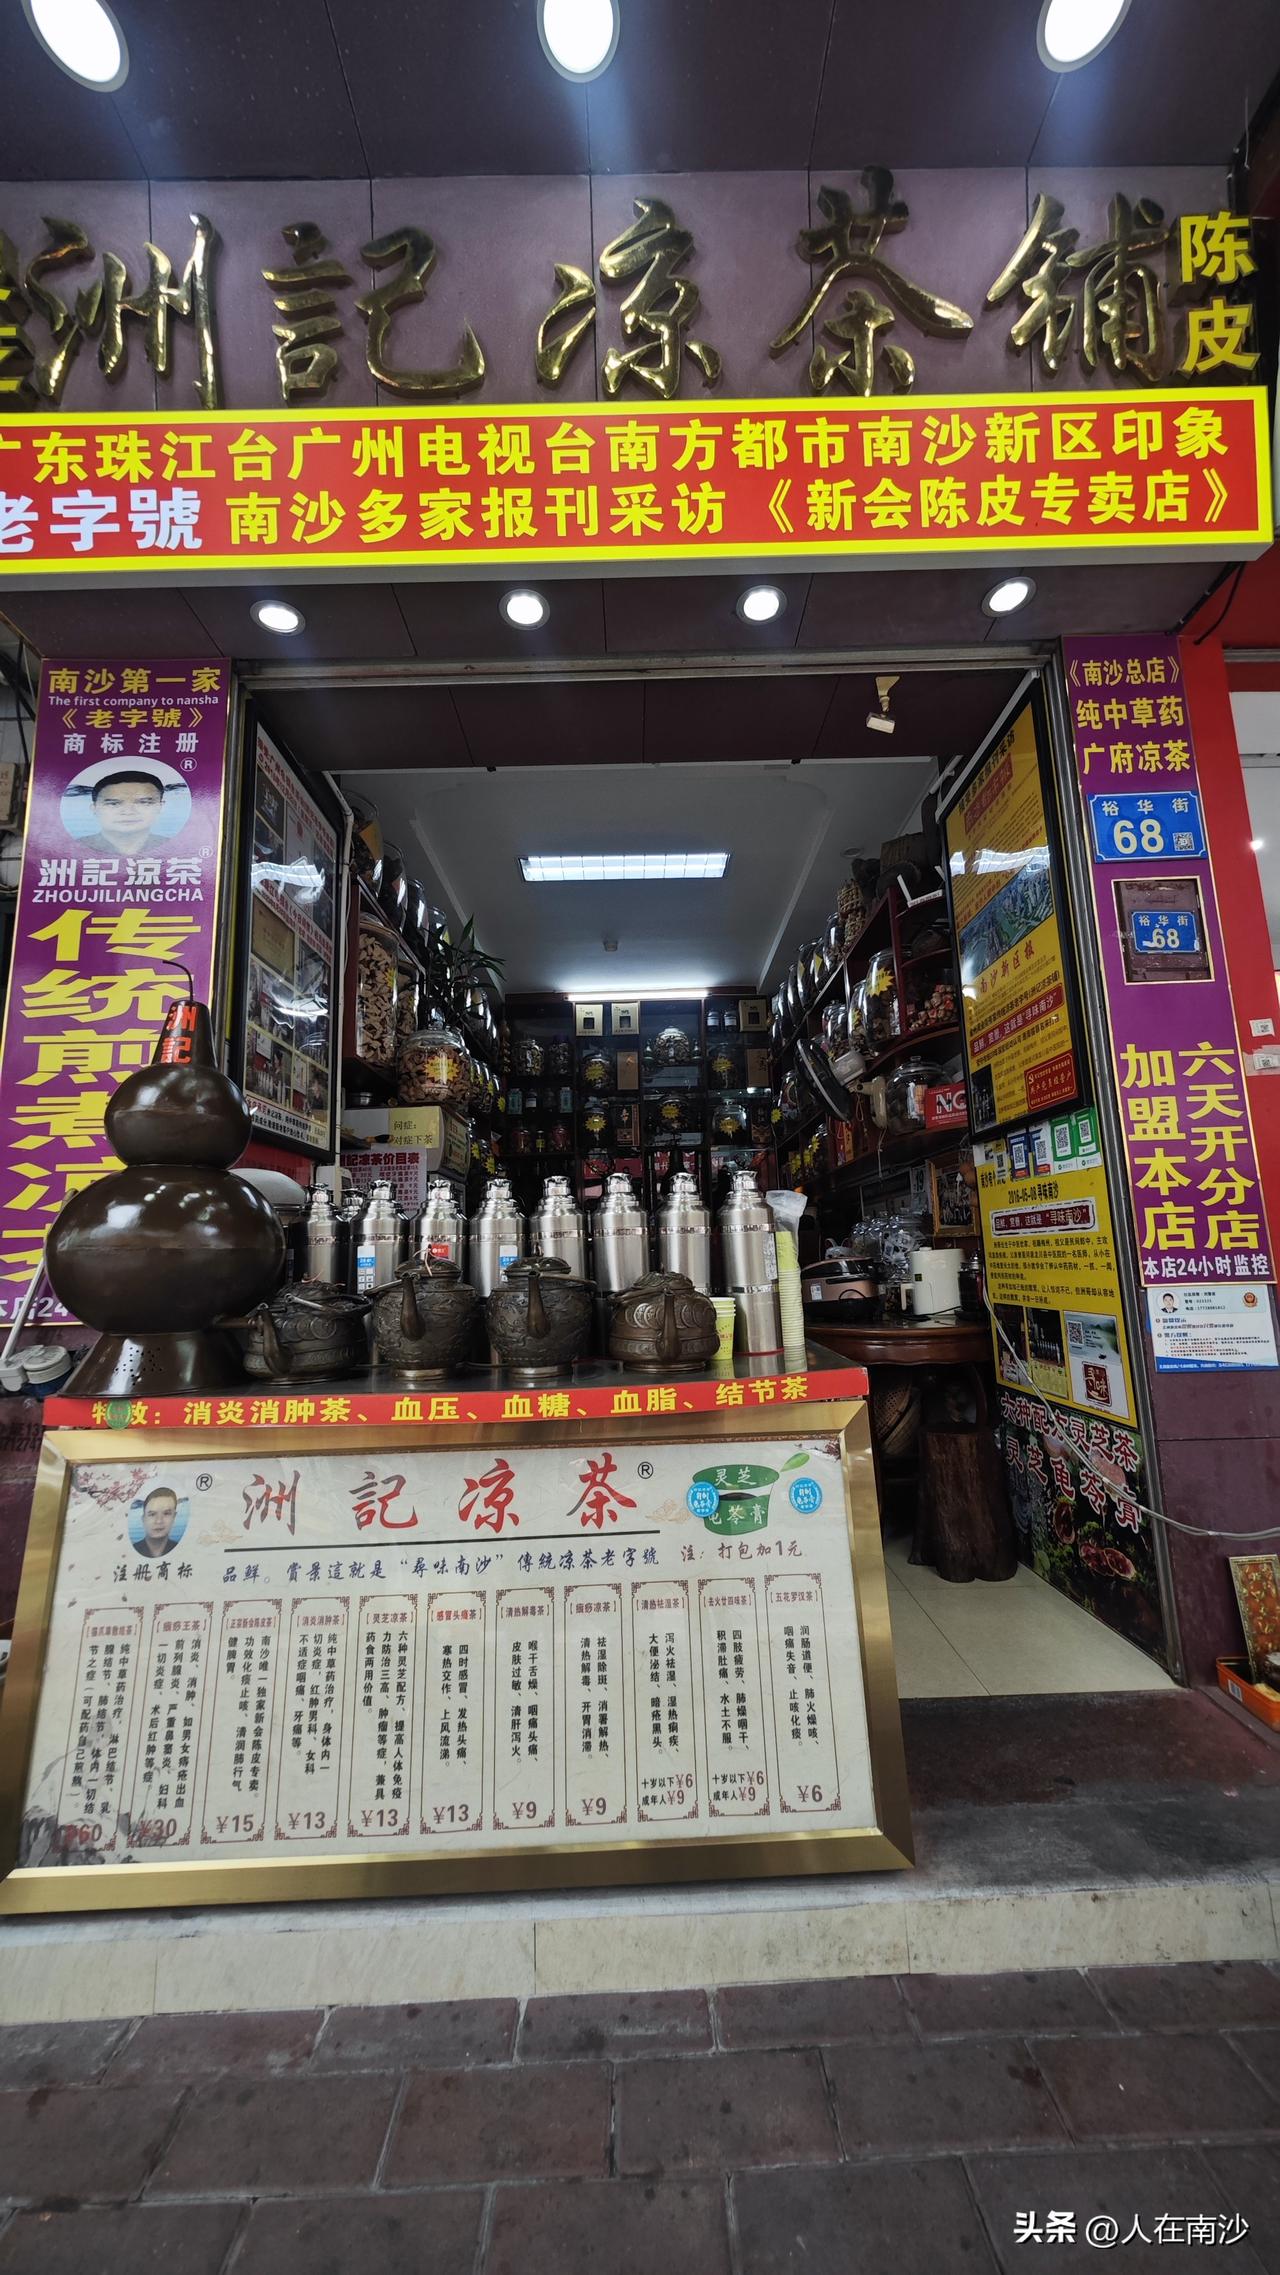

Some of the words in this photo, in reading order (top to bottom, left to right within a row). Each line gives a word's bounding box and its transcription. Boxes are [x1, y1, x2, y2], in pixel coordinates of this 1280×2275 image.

[1180, 211, 1260, 374] 陈皮
[228, 482, 727, 545] 南沙多家报刊采访
[767, 467, 1229, 534] 《新会陈皮专卖店》
[48, 667, 222, 694] 南沙第一家
[1069, 656, 1180, 687] 《南沙总店》
[48, 696, 70, 706] The
[72, 695, 101, 707] first
[103, 697, 158, 708] company
[161, 697, 174, 706] to
[176, 695, 219, 706] nansha
[1076, 695, 1184, 730] 纯中草药
[62, 707, 204, 729] 《老字號》
[63, 732, 199, 754] 商标注册
[1083, 739, 1192, 775] 广府凉茶
[1102, 797, 1189, 817] 裕华街
[1113, 819, 1165, 855] 68
[32, 888, 204, 903] ZHOUJILIANGCHA
[1138, 914, 1189, 928] 裕华街
[1152, 928, 1181, 949] 68
[160, 1004, 197, 1064] 洲記
[1120, 1044, 1197, 1251] 加盟本店
[1177, 1041, 1260, 1250] 六天开分店
[1143, 1253, 1270, 1279] 本店24小时监控
[1000, 1391, 1140, 1472] 六种配方灵芝茶
[714, 1466, 758, 1487] 灵芝
[113, 1561, 194, 1583] 注册商标
[797, 1785, 822, 1803] ¥6
[433, 1804, 469, 1824] ¥13
[512, 1801, 537, 1819] ¥9
[582, 1797, 607, 1816] ¥9
[216, 1814, 254, 1833] ¥15
[289, 1811, 326, 1830] ¥13
[361, 1809, 398, 1827] ¥13
